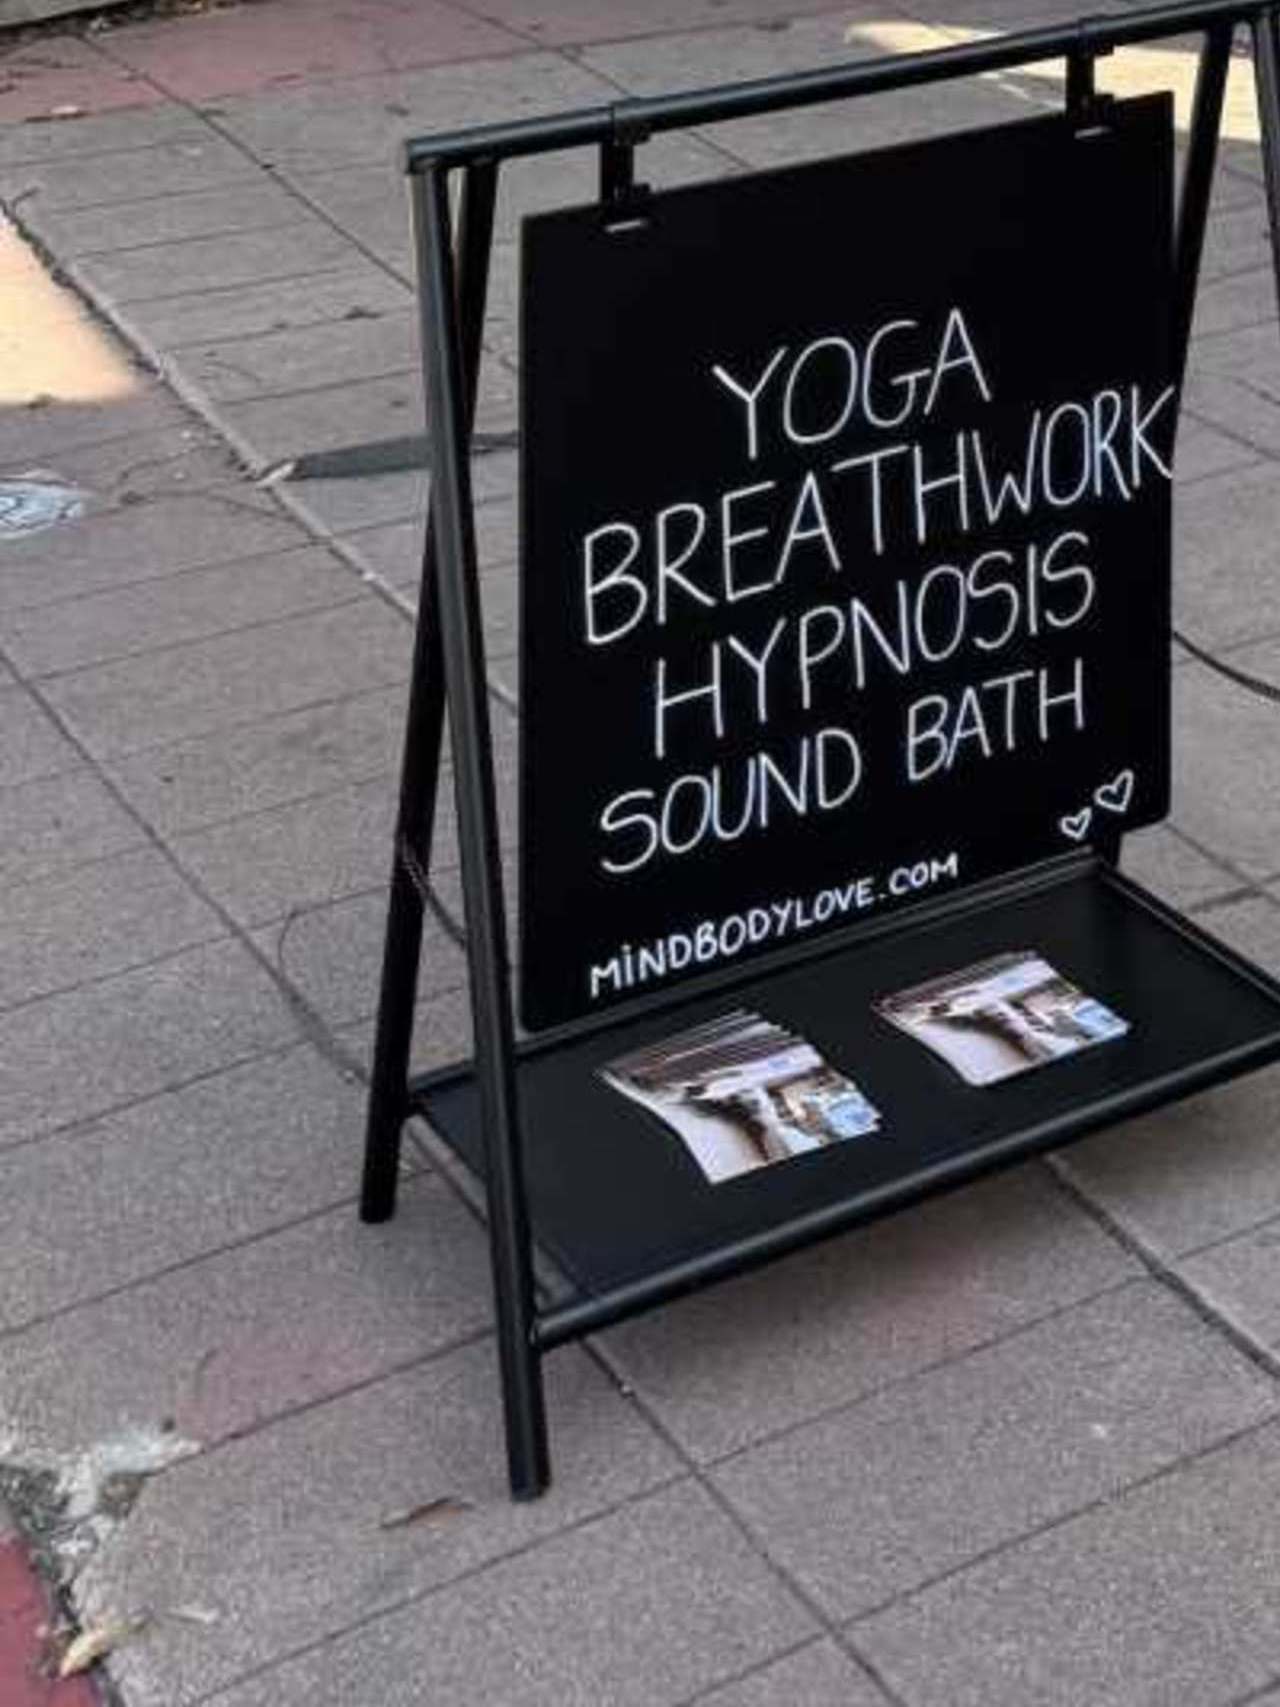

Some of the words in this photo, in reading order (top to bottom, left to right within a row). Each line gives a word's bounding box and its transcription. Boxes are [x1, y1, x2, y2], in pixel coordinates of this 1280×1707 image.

[712, 307, 993, 462] YOGA
[581, 384, 1177, 647] BREATHWORK
[653, 530, 1096, 761] HYPNOSIS
[598, 725, 862, 875] SOUND
[906, 658, 1086, 782] BATH
